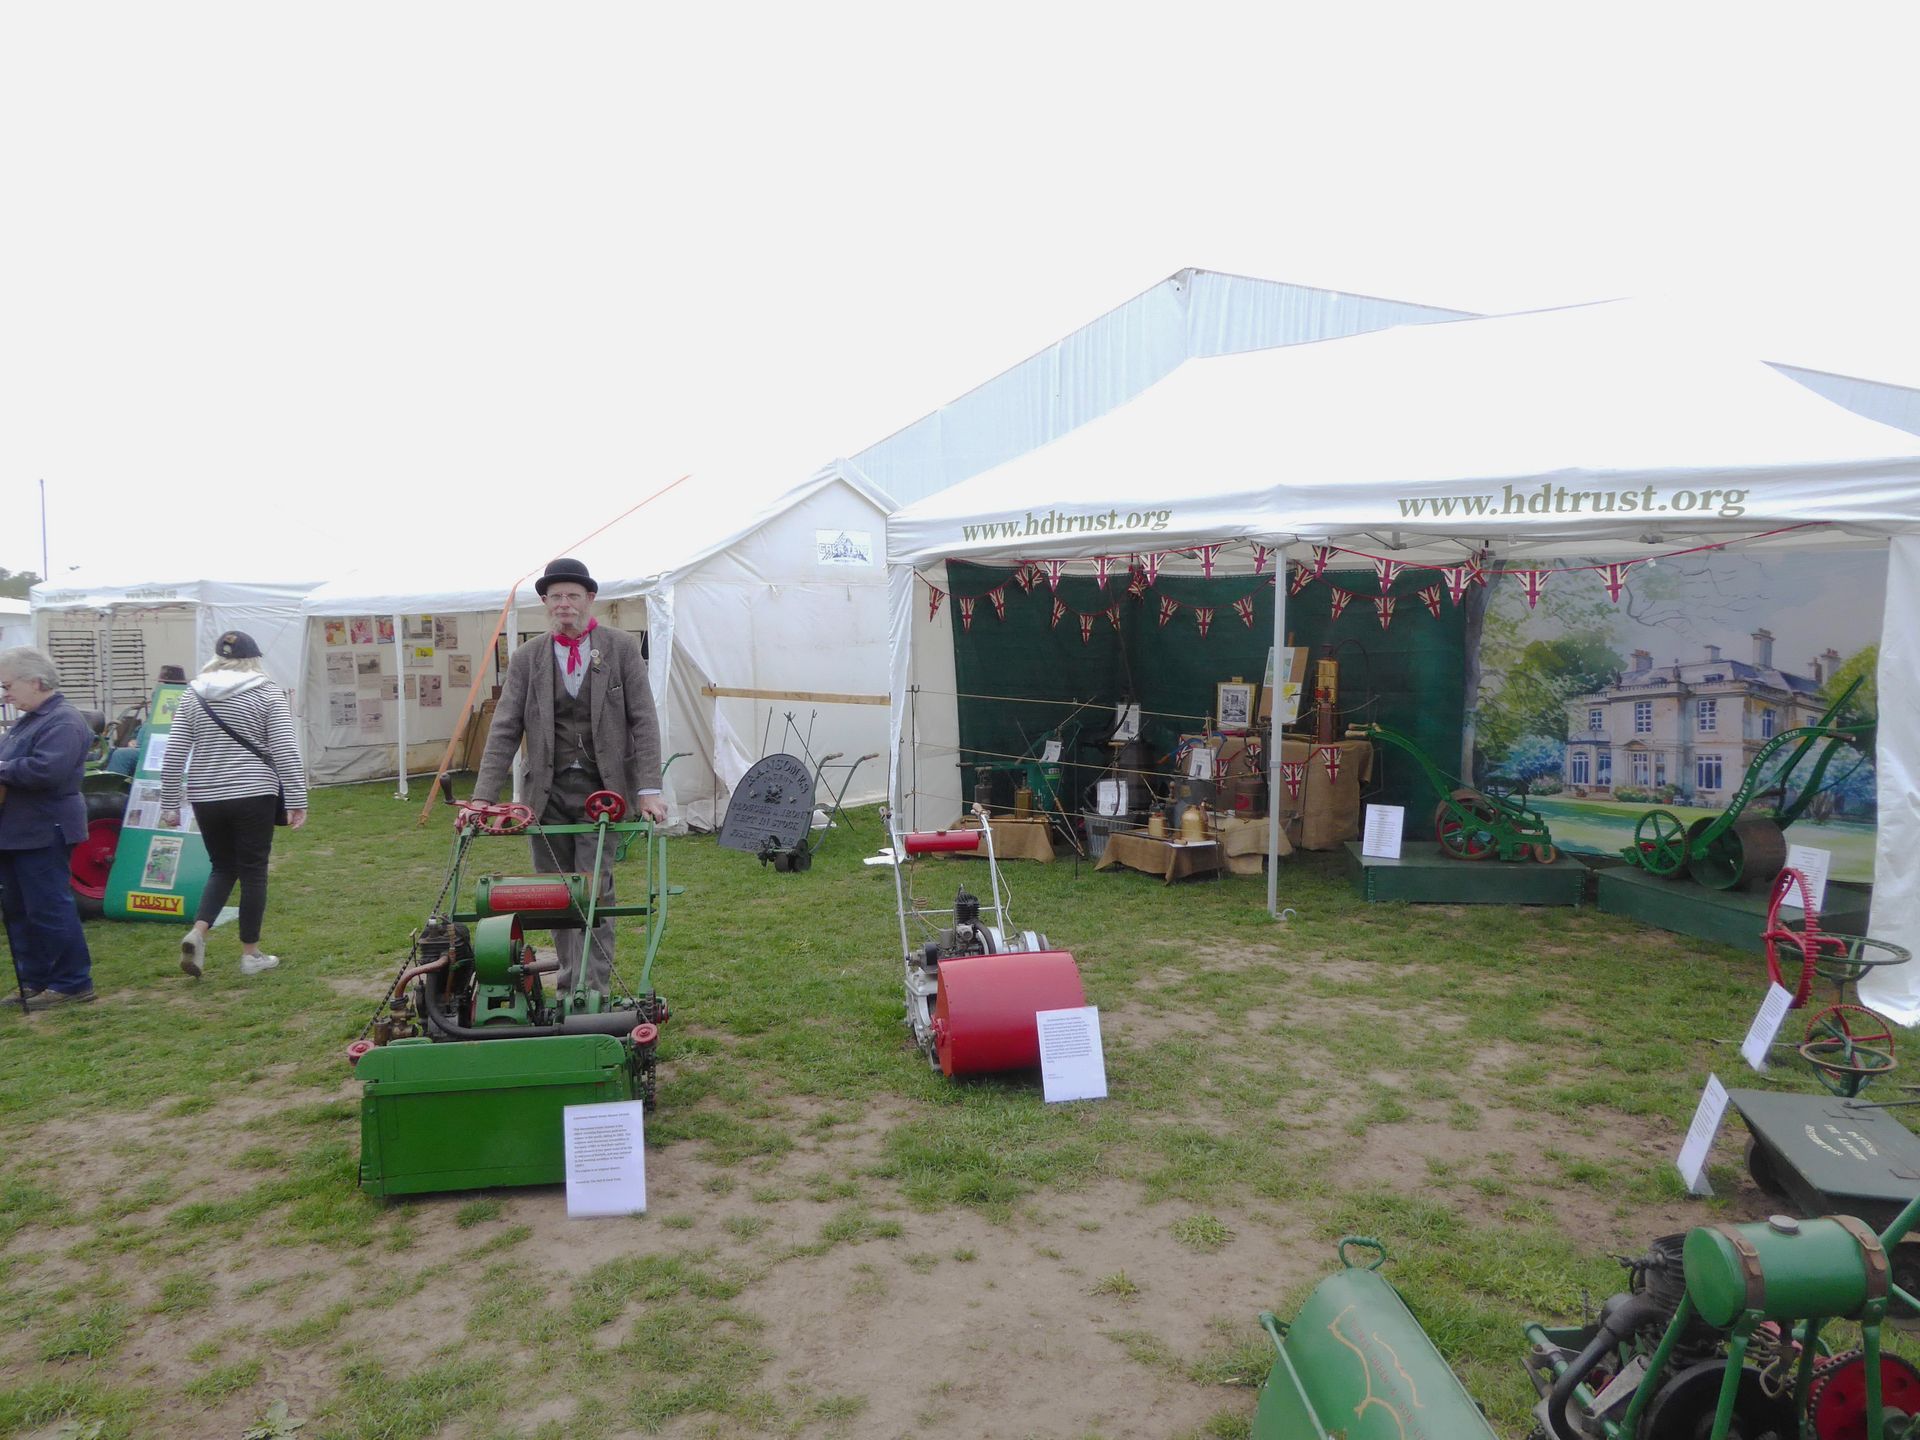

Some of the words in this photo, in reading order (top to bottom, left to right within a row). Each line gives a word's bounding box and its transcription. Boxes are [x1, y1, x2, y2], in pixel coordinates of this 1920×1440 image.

[1398, 482, 1750, 519] www.hdtrust.org
[962, 508, 1172, 543] www.hdtrust.org
[130, 894, 182, 910] TRUSTY
